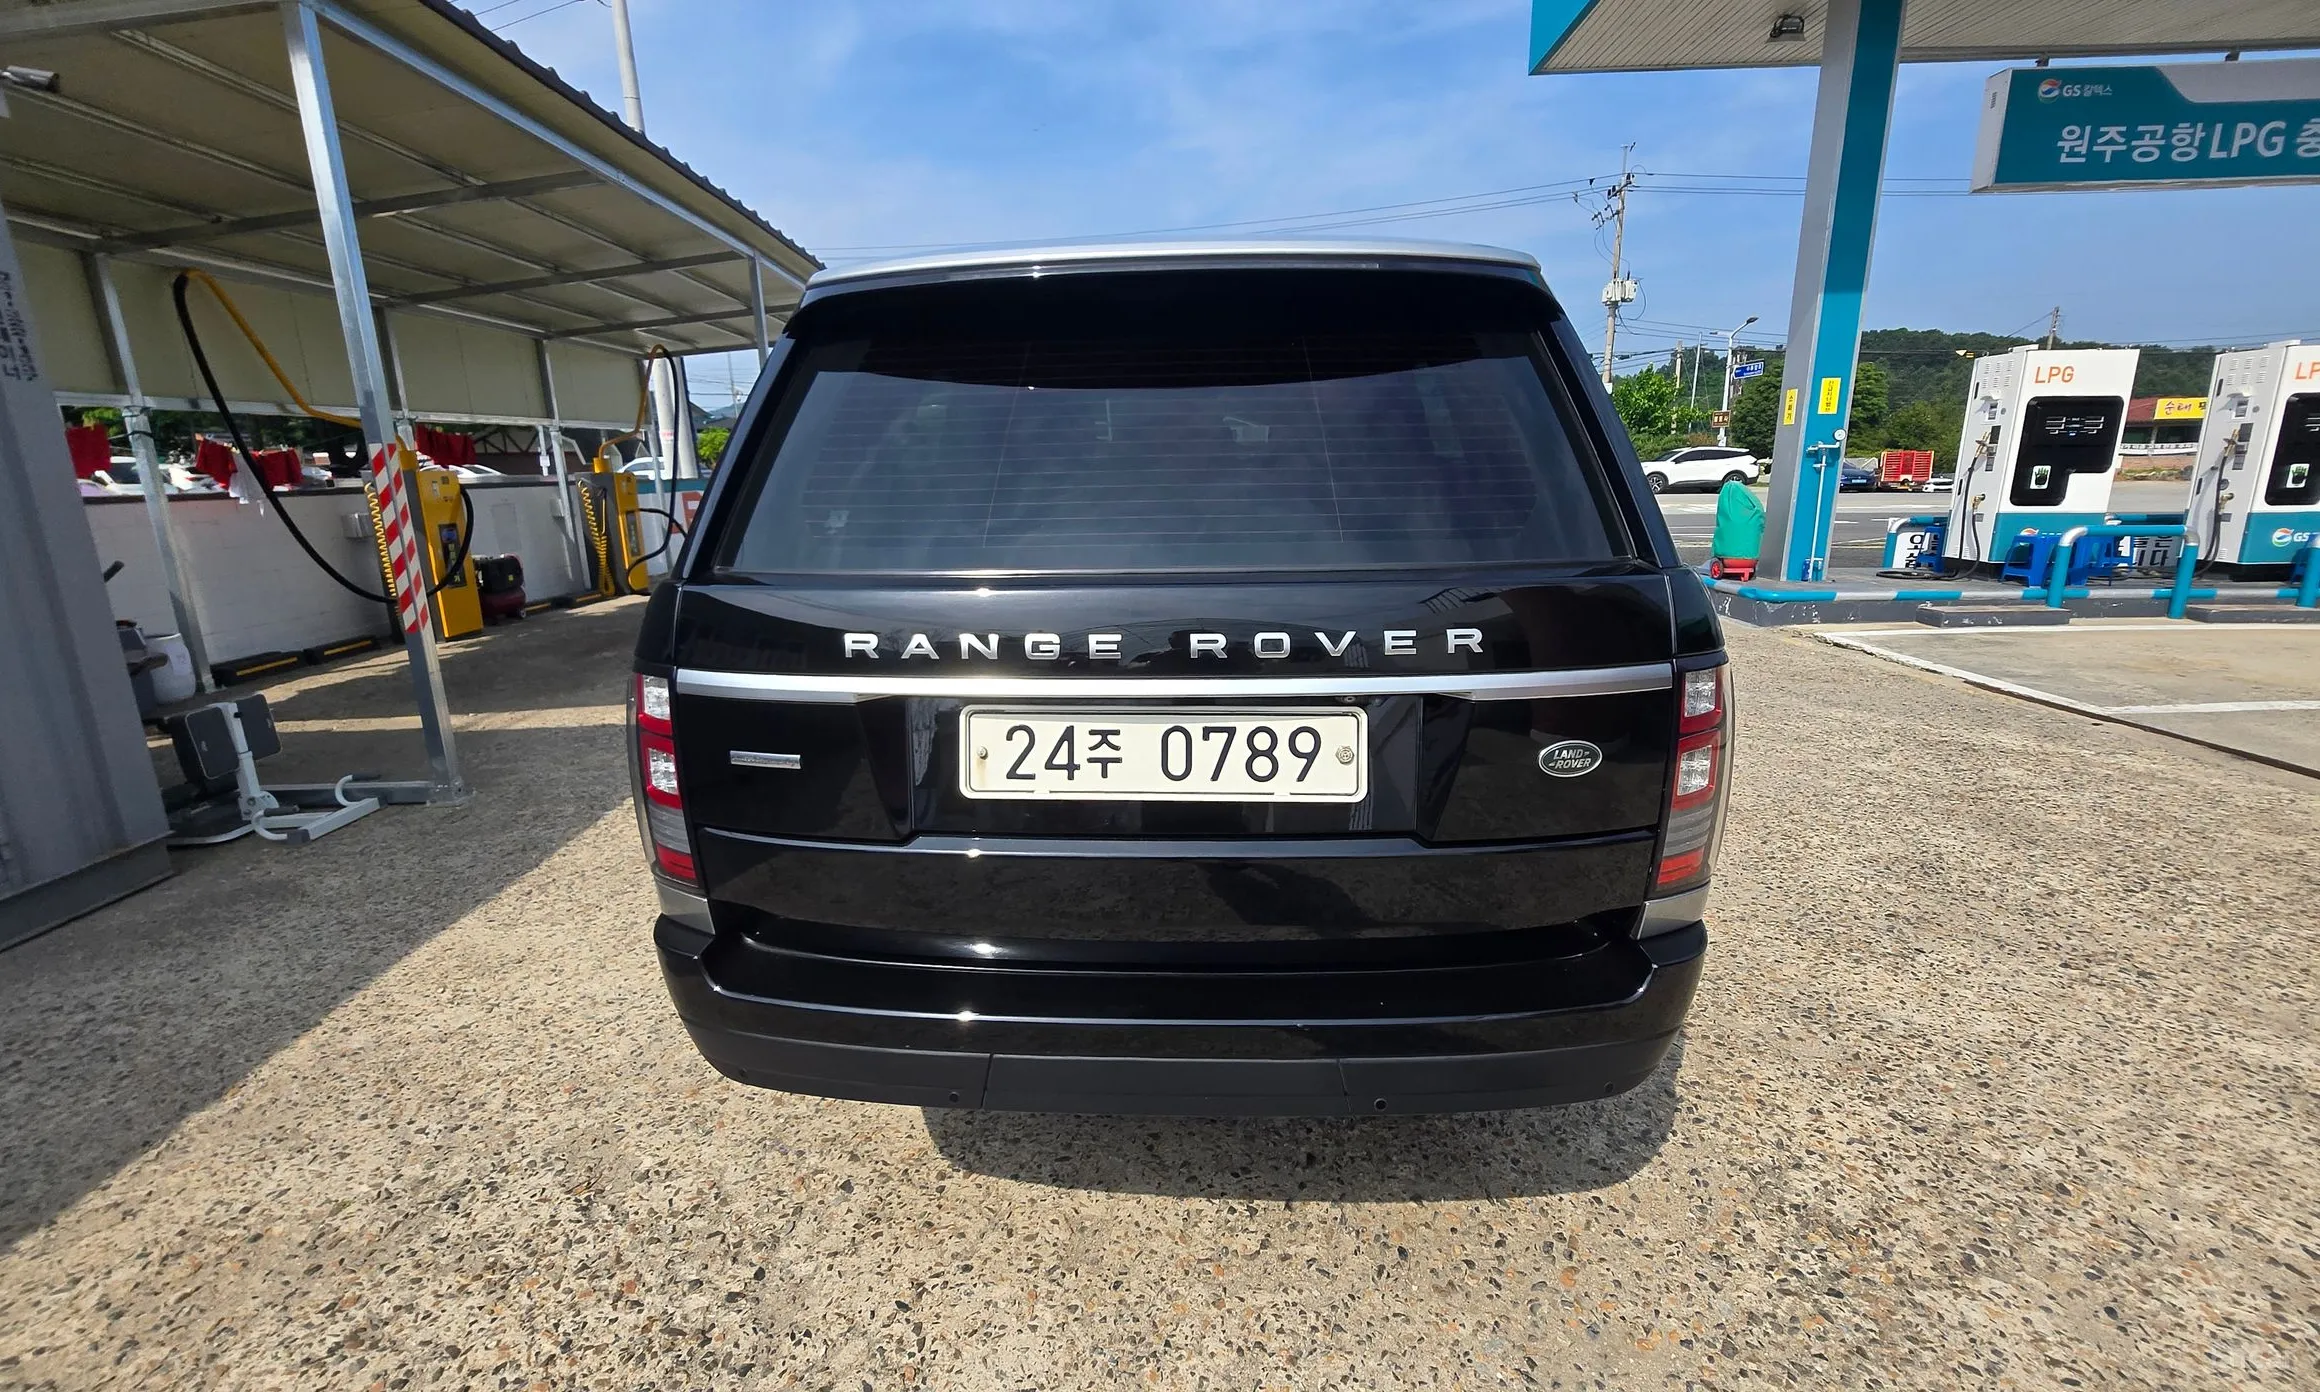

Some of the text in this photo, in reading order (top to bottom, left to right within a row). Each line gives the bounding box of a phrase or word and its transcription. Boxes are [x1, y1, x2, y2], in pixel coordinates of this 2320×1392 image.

[2034, 366, 2075, 383] LPG
[844, 628, 1484, 660] RANGE ROVER
[1005, 724, 1322, 782] 24주 0789
[1553, 749, 1584, 760] LAND
[1554, 758, 1592, 769] ROVER
